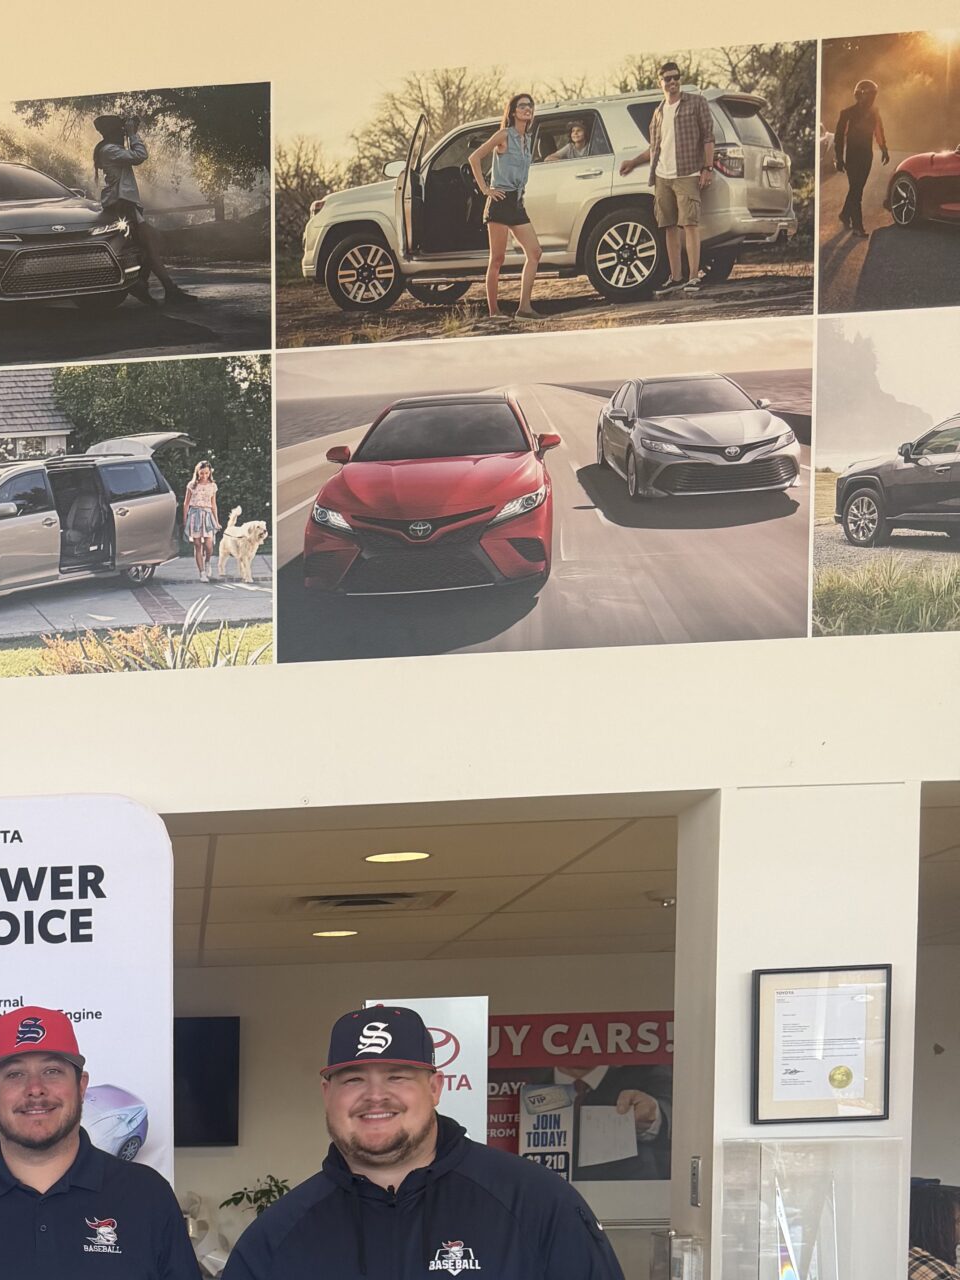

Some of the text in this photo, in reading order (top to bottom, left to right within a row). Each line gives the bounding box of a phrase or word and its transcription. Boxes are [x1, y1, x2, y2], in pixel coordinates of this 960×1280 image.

[57, 1008, 102, 1023] ngine
[488, 1022, 674, 1057] UY CARS!
[533, 1114, 561, 1130] JOIN
[526, 1131, 567, 1147] TODAY!
[83, 1245, 122, 1253] BASEBALL
[428, 1260, 481, 1270] BASEBALL
